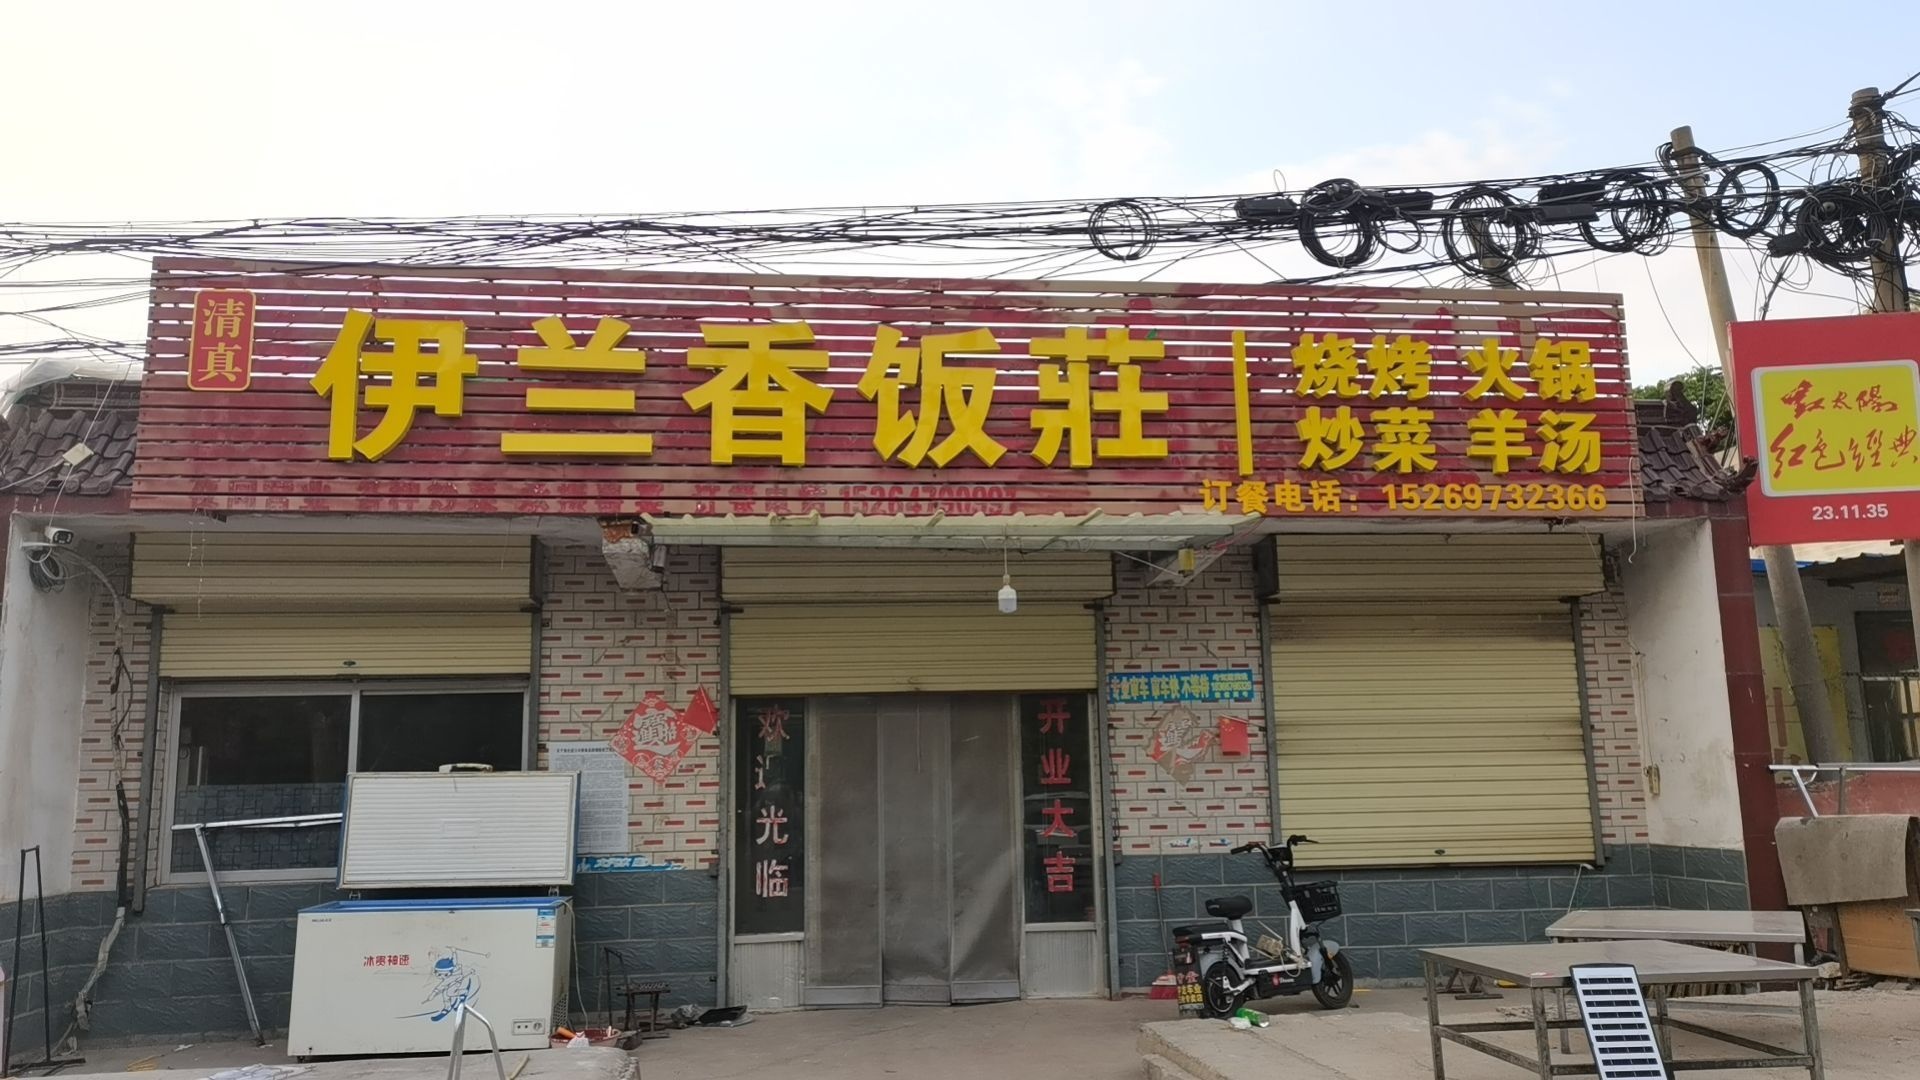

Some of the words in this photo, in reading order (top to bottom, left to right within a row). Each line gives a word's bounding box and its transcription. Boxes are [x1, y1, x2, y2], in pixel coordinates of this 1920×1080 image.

[197, 297, 246, 384] 清真
[1291, 332, 1434, 401] 烧烤
[1462, 336, 1599, 404] 火锅
[1295, 404, 1439, 475] 炒菜
[1466, 408, 1603, 476] 羊汤
[1380, 482, 1609, 514] 15269732366
[1811, 503, 1889, 521] 23.11.35
[1037, 699, 1077, 893] 开业大吉
